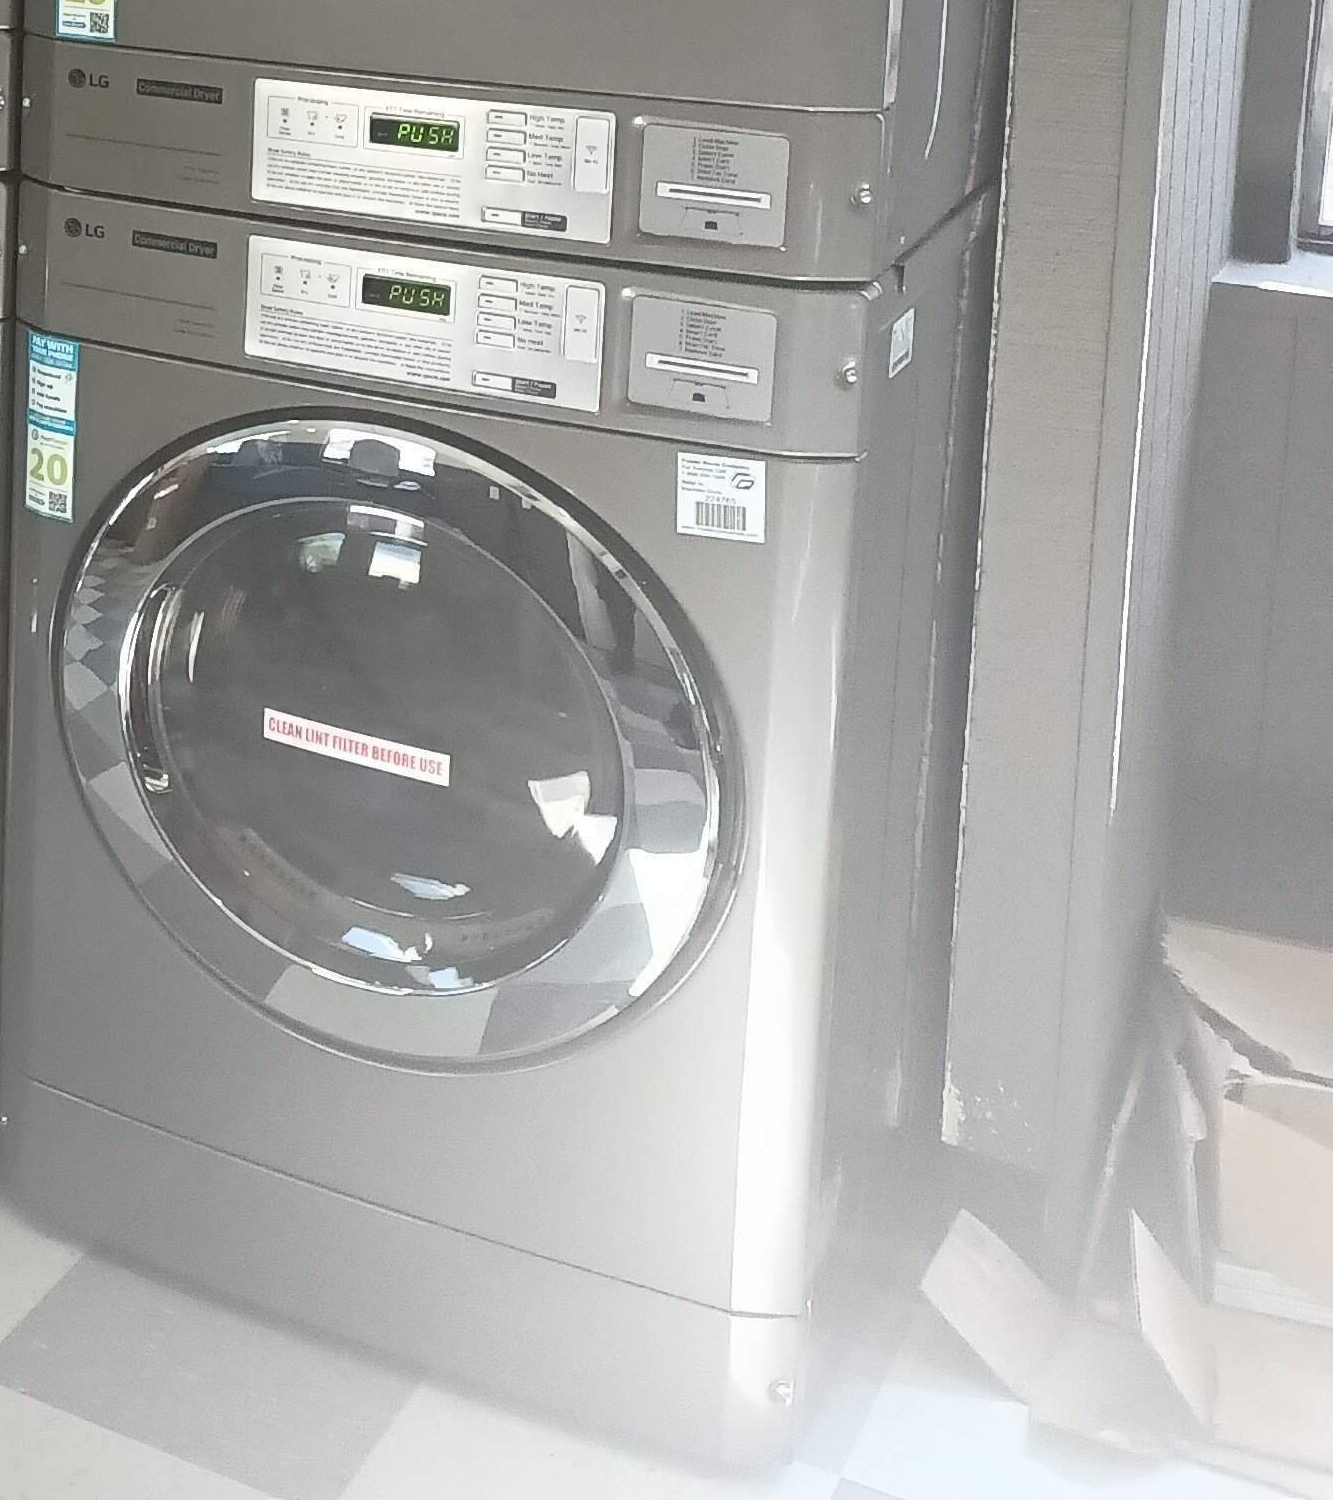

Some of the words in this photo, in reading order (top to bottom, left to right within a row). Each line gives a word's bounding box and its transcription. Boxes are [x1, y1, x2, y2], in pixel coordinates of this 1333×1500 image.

[89, 74, 109, 88] LG
[139, 81, 192, 98] Commercial
[194, 89, 221, 101] Dryer
[398, 123, 454, 145] PUSH
[85, 224, 104, 238] LG
[135, 233, 186, 251] Commercial
[188, 242, 215, 257] Dryer
[389, 285, 445, 307] PUSH
[33, 336, 46, 348] PAY
[48, 338, 73, 354] WITH
[30, 448, 68, 485] 20
[269, 717, 303, 740] CLEAN
[306, 727, 330, 749] LINT
[333, 735, 369, 757] FILTER
[372, 745, 416, 770] BEFORE
[419, 758, 442, 776] USE
